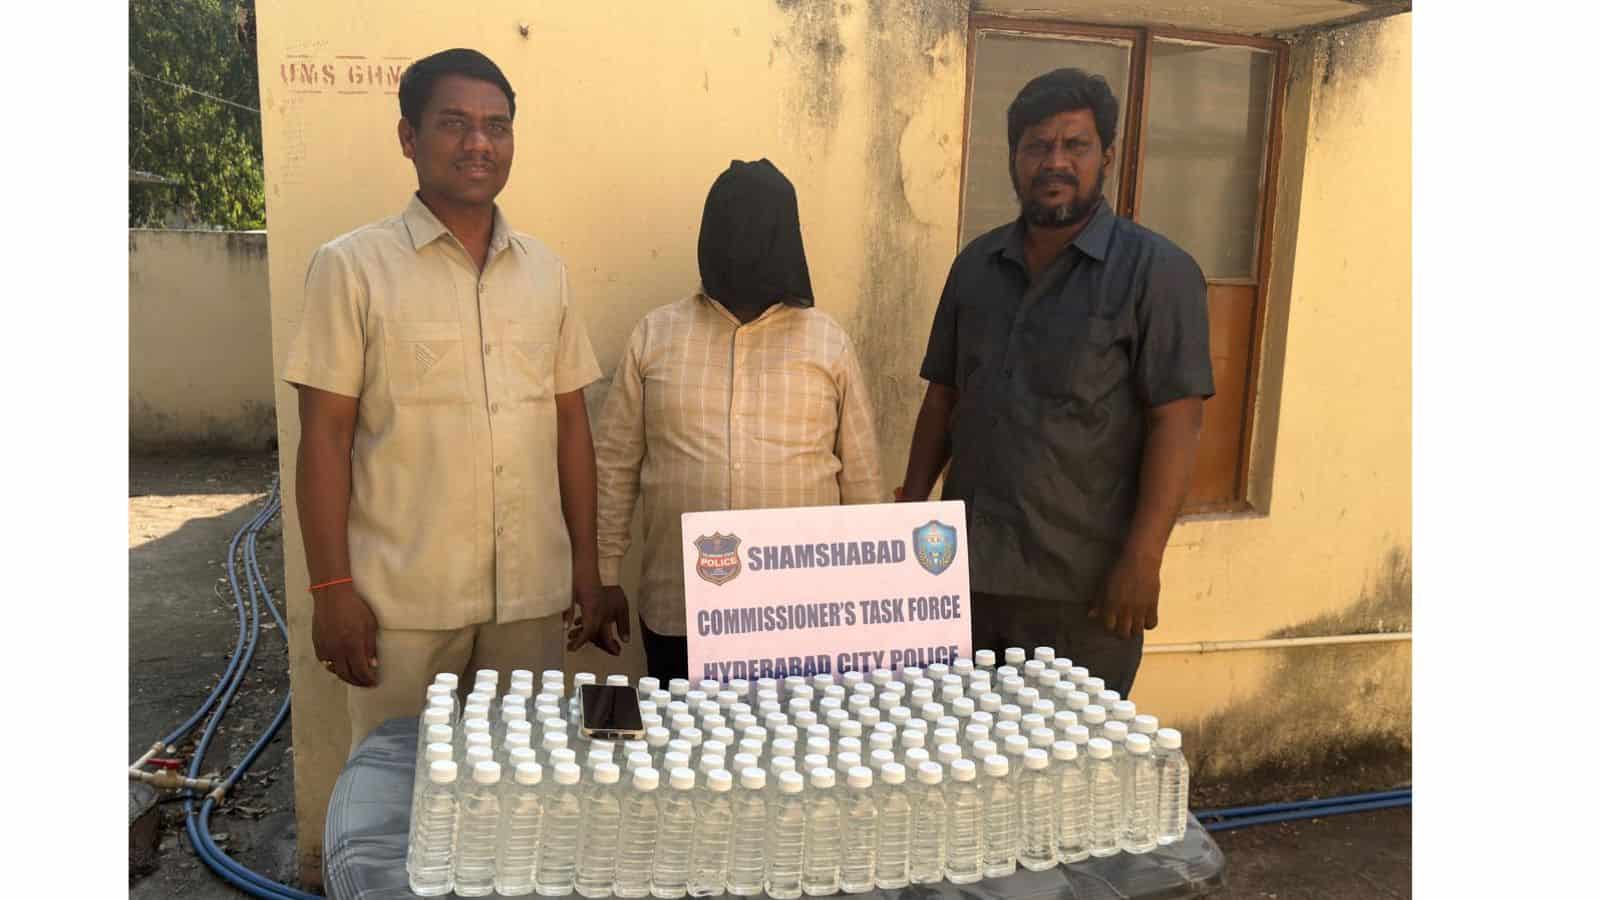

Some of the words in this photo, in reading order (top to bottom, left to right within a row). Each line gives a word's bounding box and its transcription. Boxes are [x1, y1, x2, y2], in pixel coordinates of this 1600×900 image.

[701, 557, 738, 568] POLICE
[747, 539, 906, 571] SHAMSHABAD
[697, 601, 856, 636] COMMISSIONER'S
[859, 598, 905, 625] TASK
[907, 595, 961, 622] FORCE
[703, 654, 831, 684] HYDERABAD
[837, 649, 885, 674] CITY
